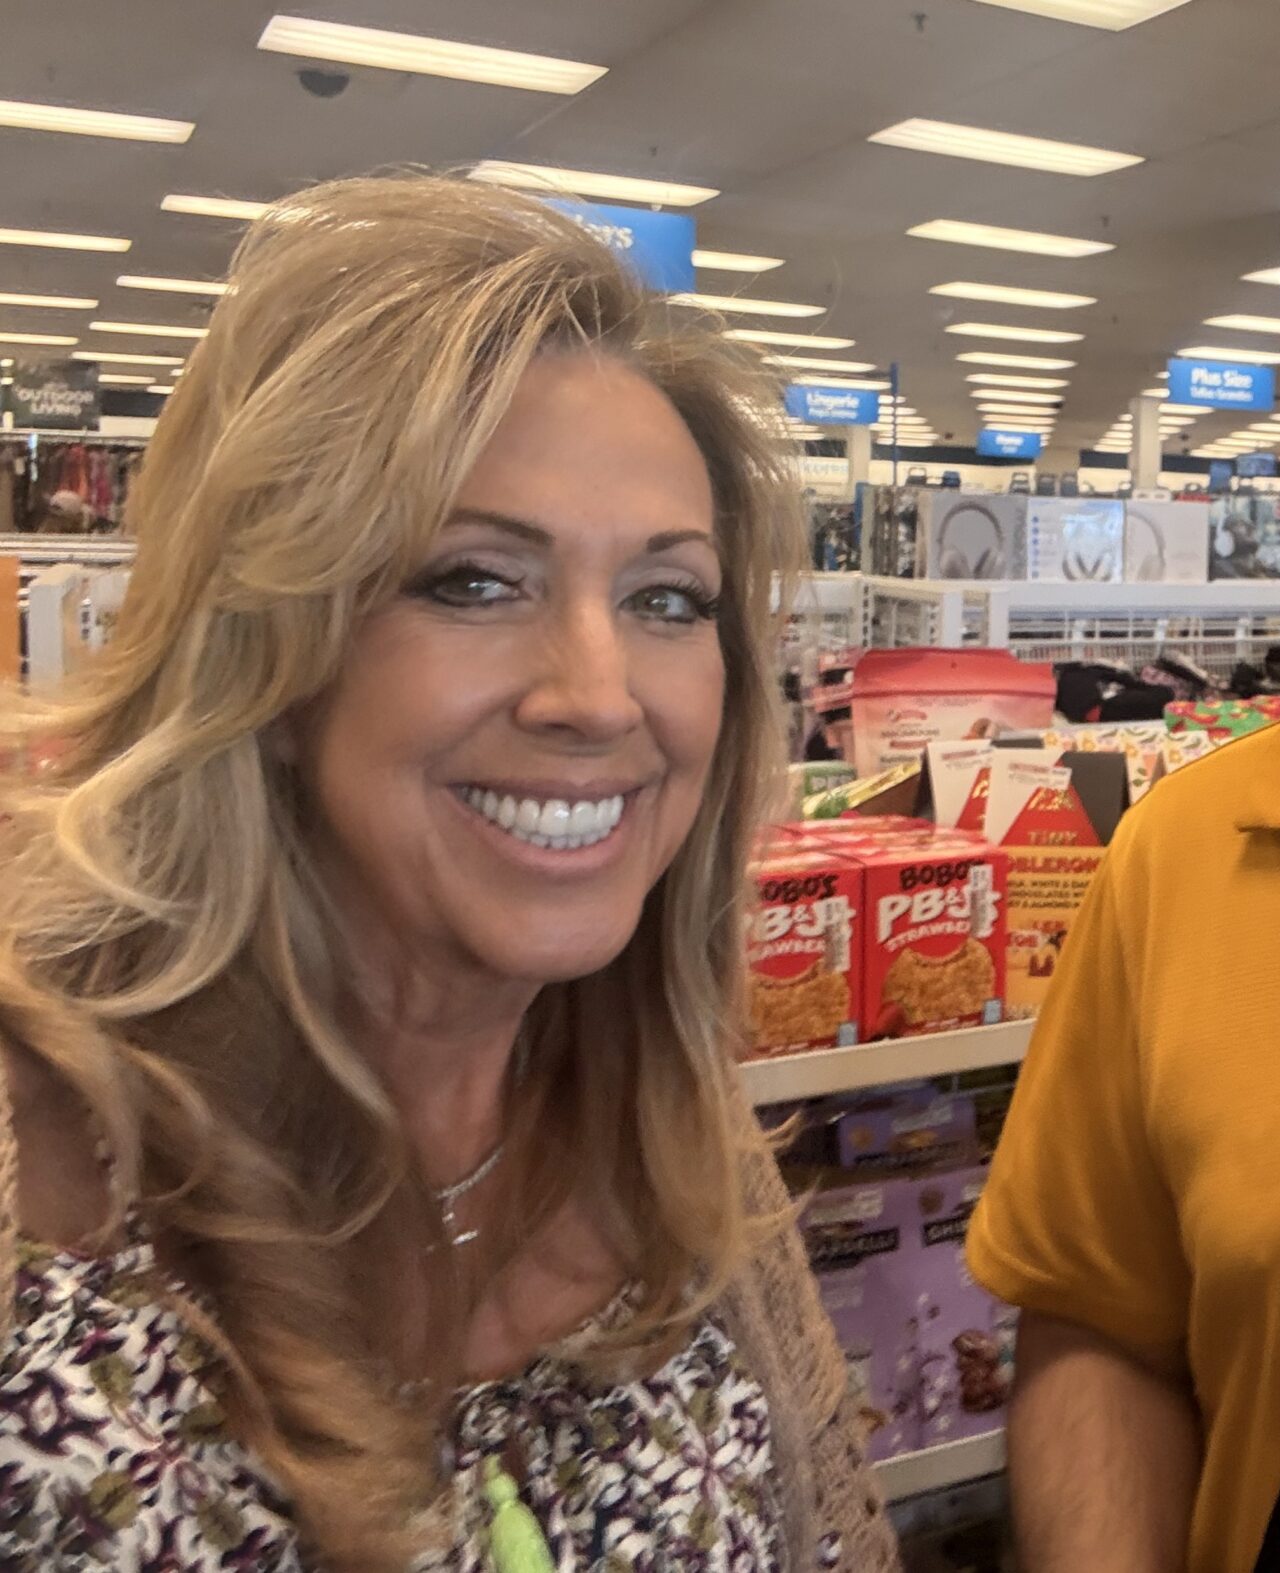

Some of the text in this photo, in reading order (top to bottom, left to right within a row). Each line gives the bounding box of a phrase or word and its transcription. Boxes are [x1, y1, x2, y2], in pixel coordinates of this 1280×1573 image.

[1190, 367, 1253, 389] Plus Size
[17, 388, 94, 402] OUTDOOR
[30, 401, 82, 415] LIVING
[1028, 830, 1078, 847] TINY
[761, 873, 839, 903] OBO'S
